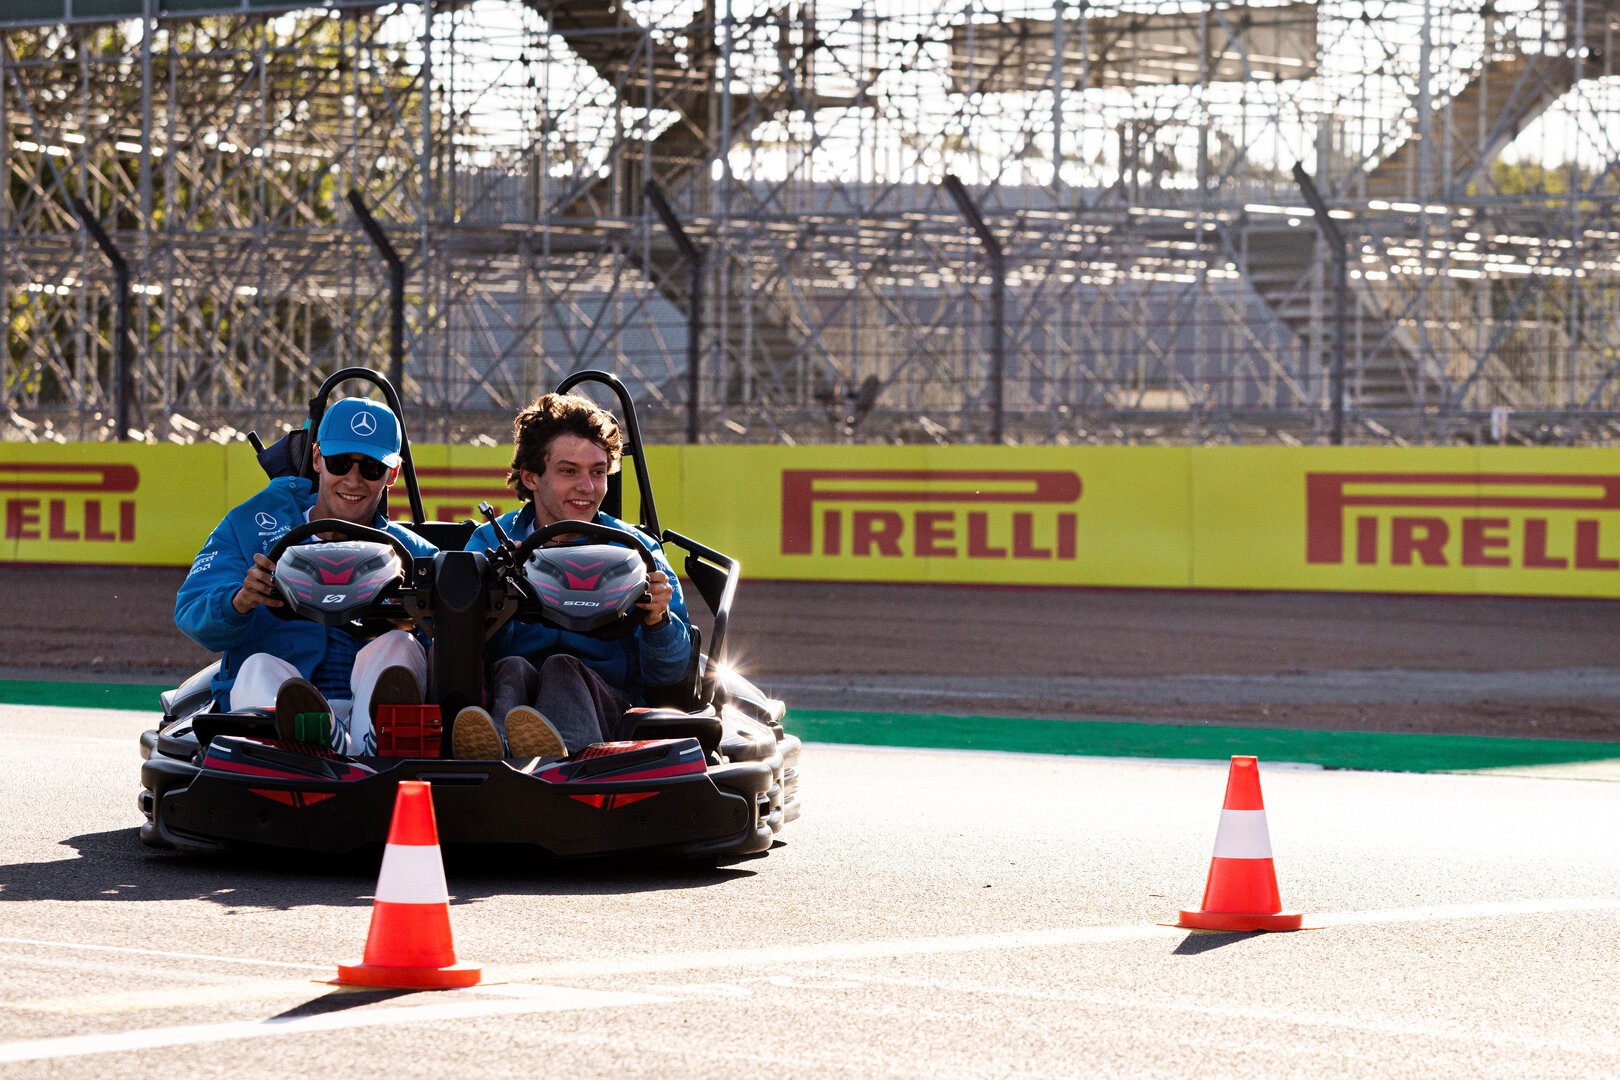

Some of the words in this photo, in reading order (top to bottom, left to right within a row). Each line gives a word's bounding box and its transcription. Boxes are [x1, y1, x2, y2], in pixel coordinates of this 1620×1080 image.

[0, 463, 140, 543] ELLI
[781, 469, 1083, 560] PIRELLI
[1306, 472, 1620, 570] PIRELL
